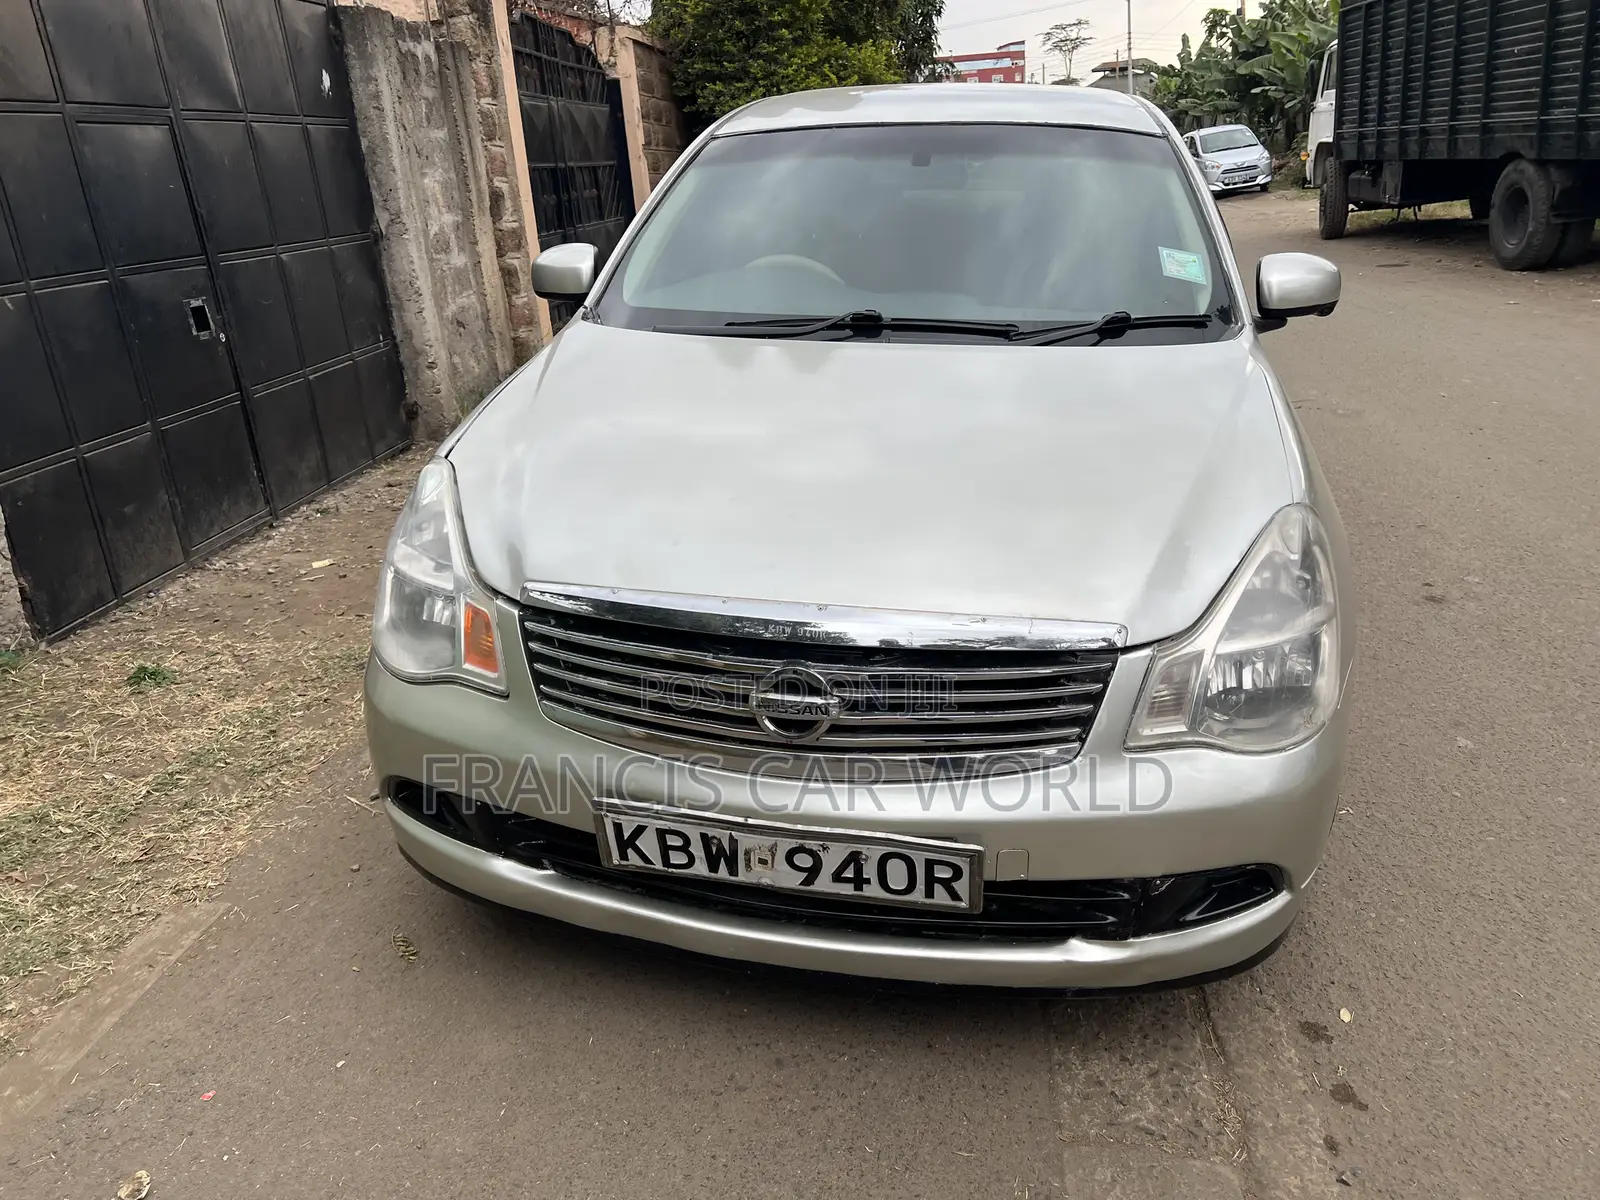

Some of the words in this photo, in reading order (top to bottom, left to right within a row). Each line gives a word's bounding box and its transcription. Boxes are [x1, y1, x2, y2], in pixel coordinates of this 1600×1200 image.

[755, 702, 829, 717] NISSAN
[611, 820, 740, 878] KBW
[784, 845, 965, 902] 940R
